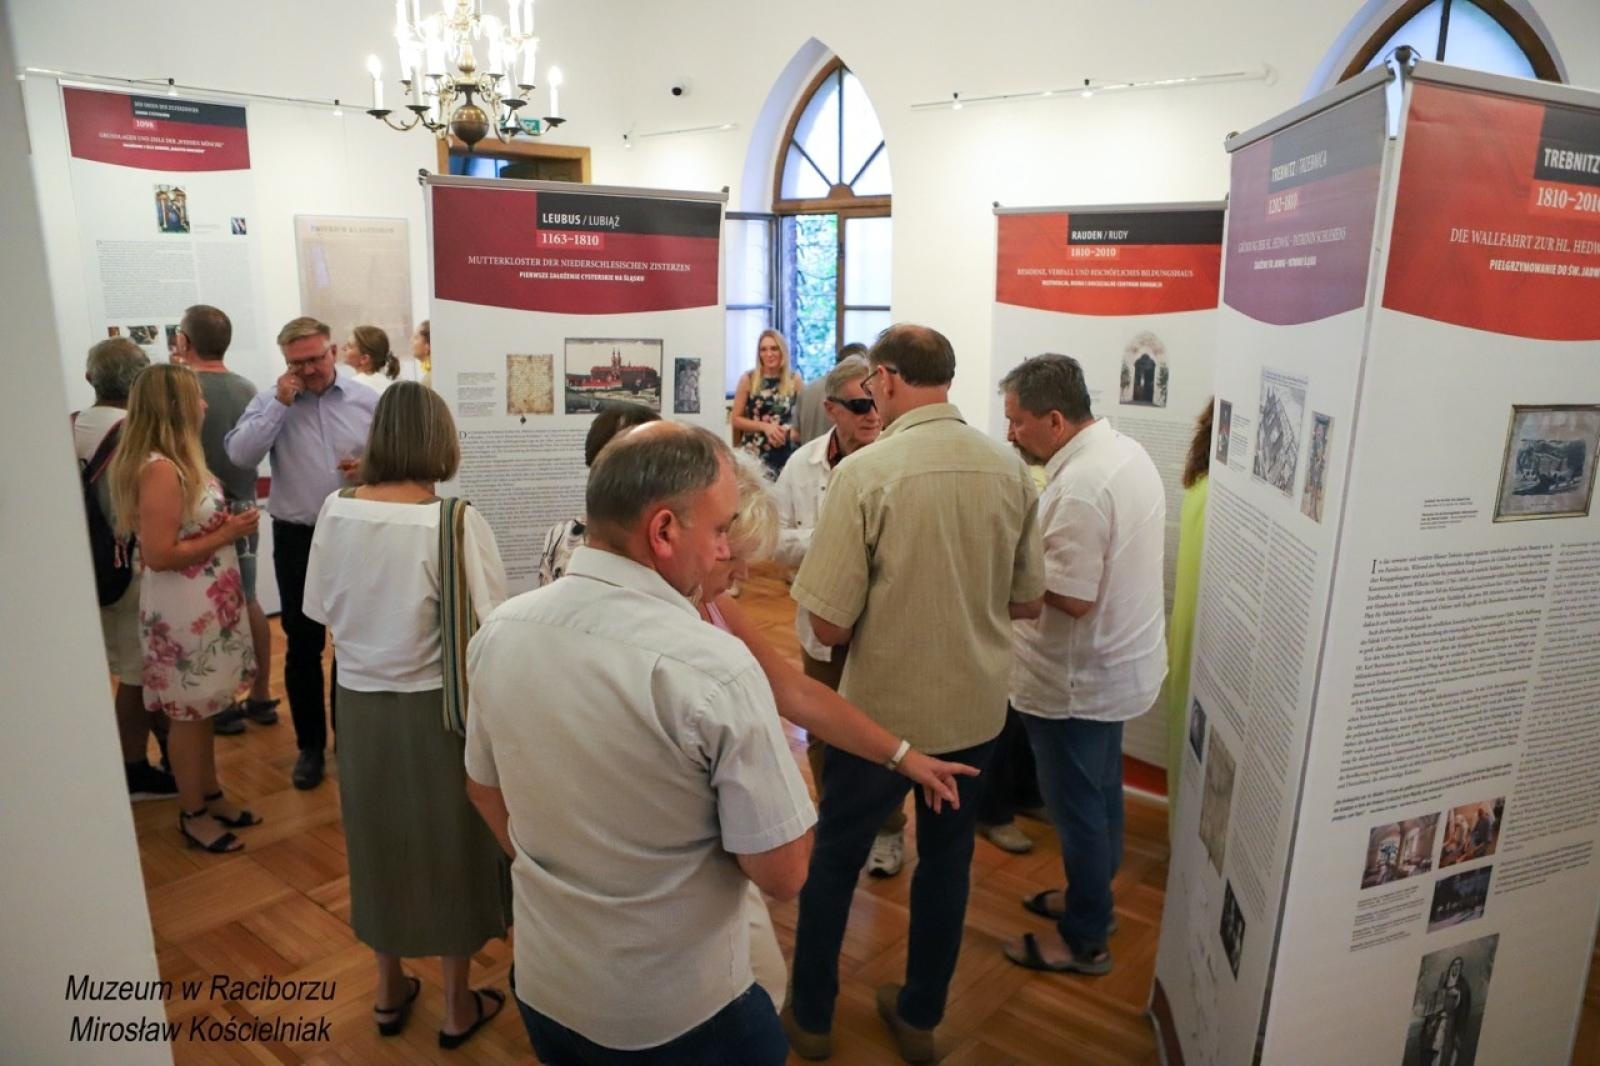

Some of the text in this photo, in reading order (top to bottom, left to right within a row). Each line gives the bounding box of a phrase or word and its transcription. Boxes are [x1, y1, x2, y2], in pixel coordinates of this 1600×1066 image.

[1544, 148, 1600, 174] TREBNITZ
[542, 212, 580, 226] LEUBUS
[588, 214, 620, 230] LUBIĄŻ
[542, 232, 600, 246] 1163-1810
[1072, 230, 1102, 240] RAUDEN
[1109, 230, 1129, 240] RUDY
[1450, 228, 1470, 244] DIE
[1472, 230, 1534, 249] WALLFAHRT
[1534, 236, 1555, 251] ZUR
[1556, 238, 1571, 252] HL.
[1071, 248, 1117, 257] 1810-2010
[468, 256, 692, 272] MUTTERKLOSTER DER NIEDERSCHLESISCHEN ZISTERZEN
[1490, 259, 1556, 274] PIELGRZYMOWANIE
[1557, 264, 1567, 276] DO
